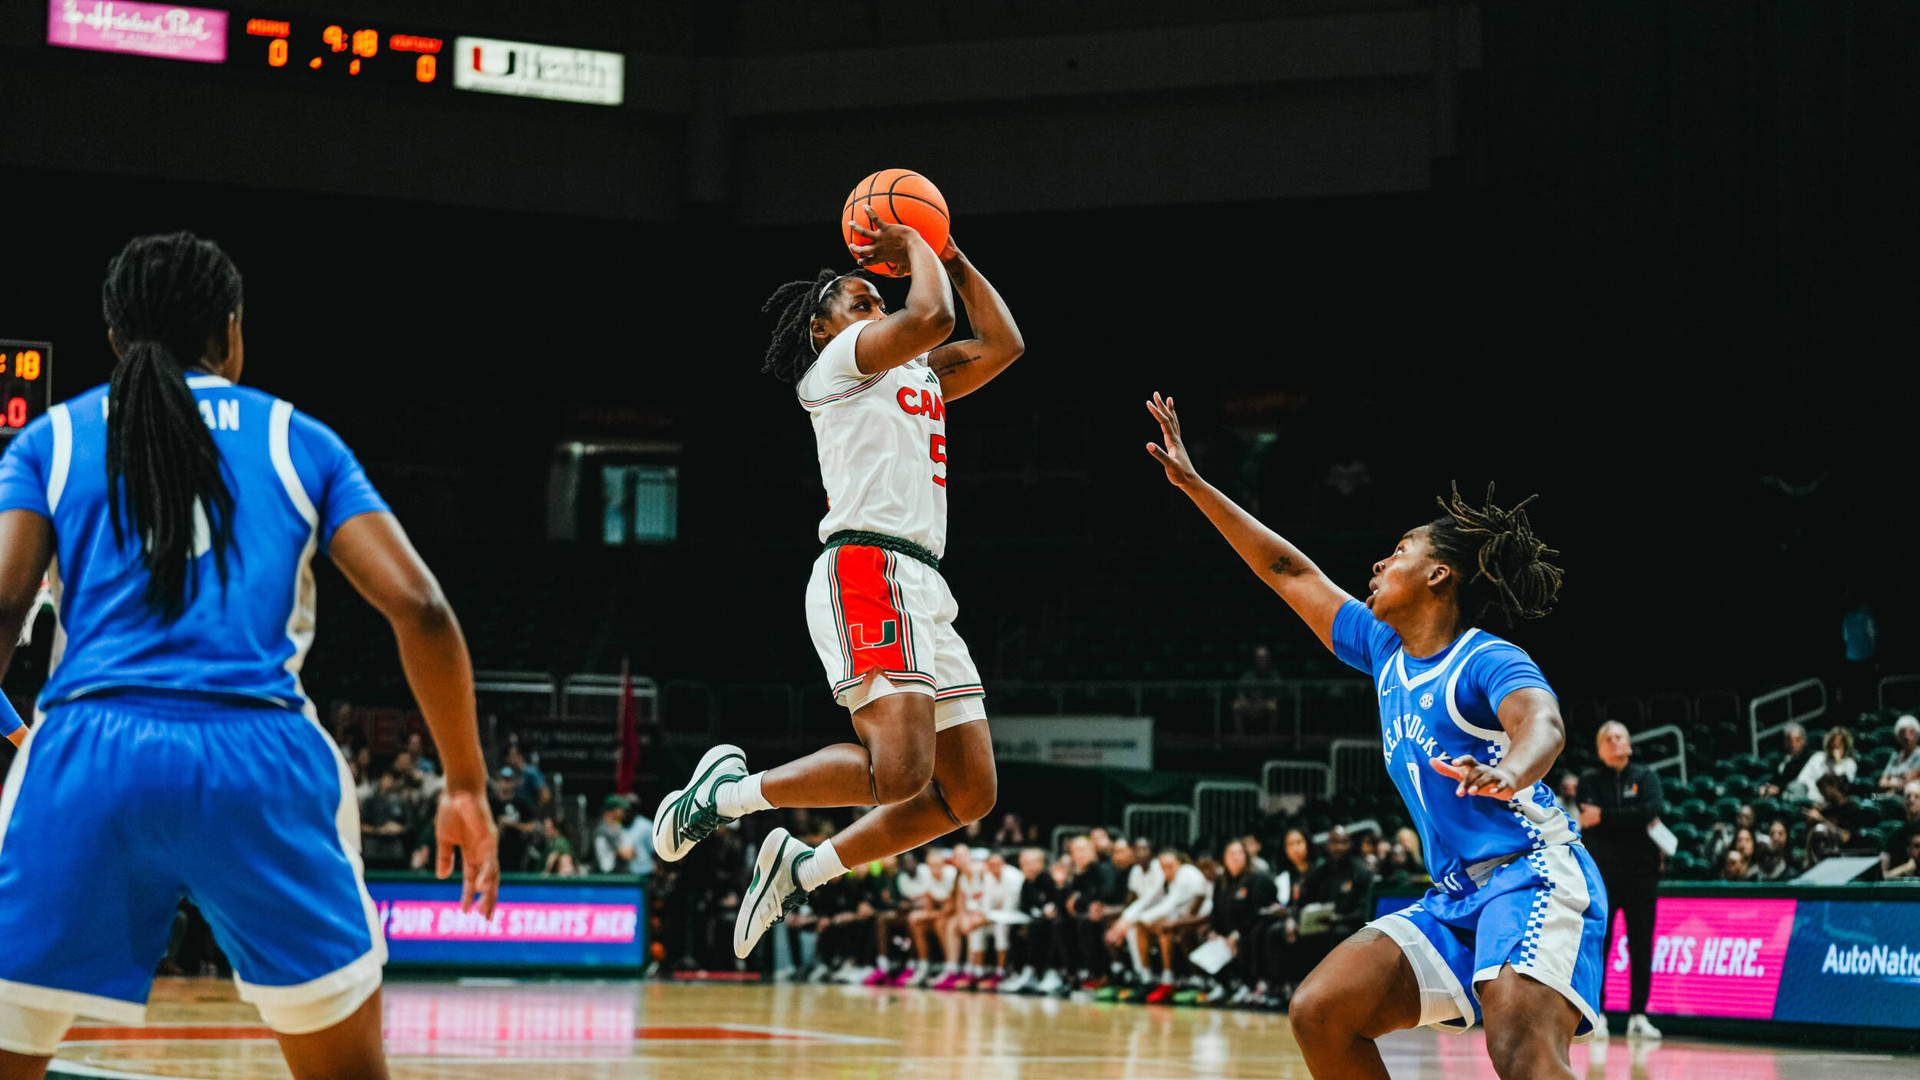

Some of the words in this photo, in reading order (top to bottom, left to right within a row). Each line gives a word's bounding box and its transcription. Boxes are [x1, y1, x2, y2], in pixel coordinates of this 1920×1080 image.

[508, 909, 589, 936] STARTS
[1614, 935, 1696, 975] SRTS
[1699, 937, 1765, 977] HERE.
